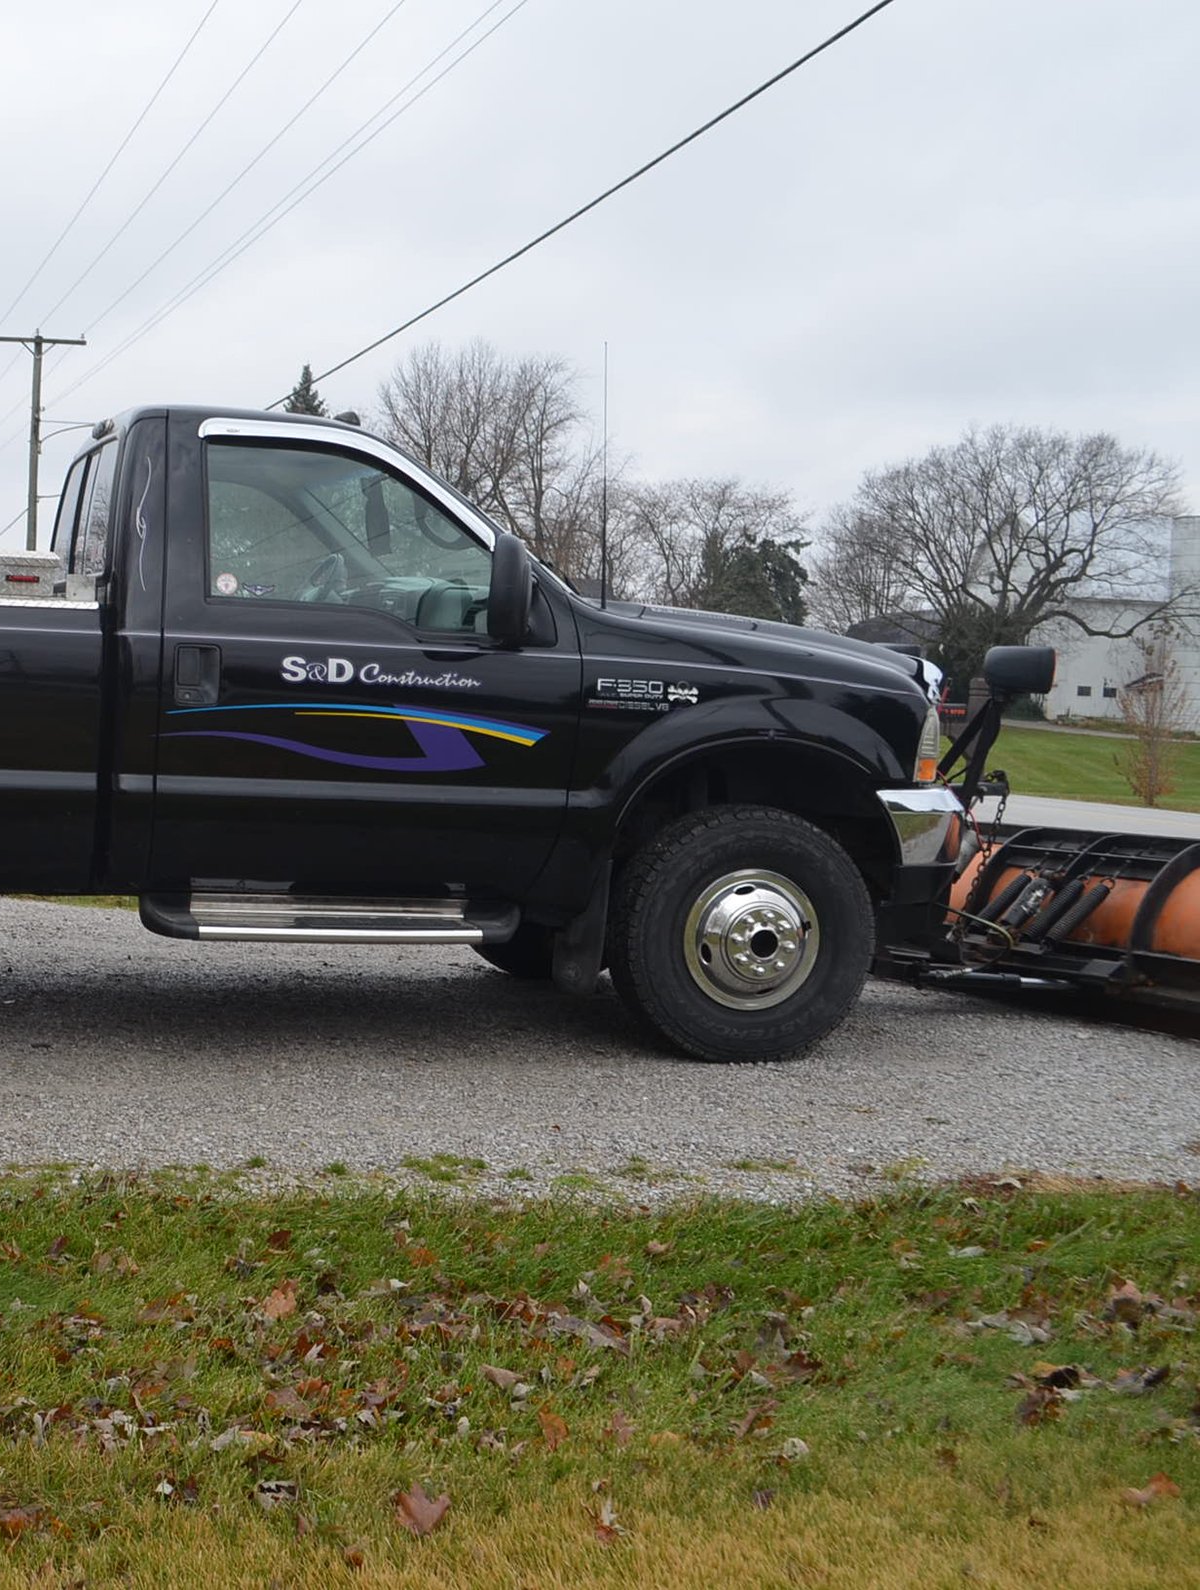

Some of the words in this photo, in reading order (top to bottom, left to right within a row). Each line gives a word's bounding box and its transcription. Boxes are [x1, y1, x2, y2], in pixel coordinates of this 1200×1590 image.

[282, 656, 354, 683] S&D
[359, 663, 481, 687] Construction
[655, 703, 670, 711] V8
